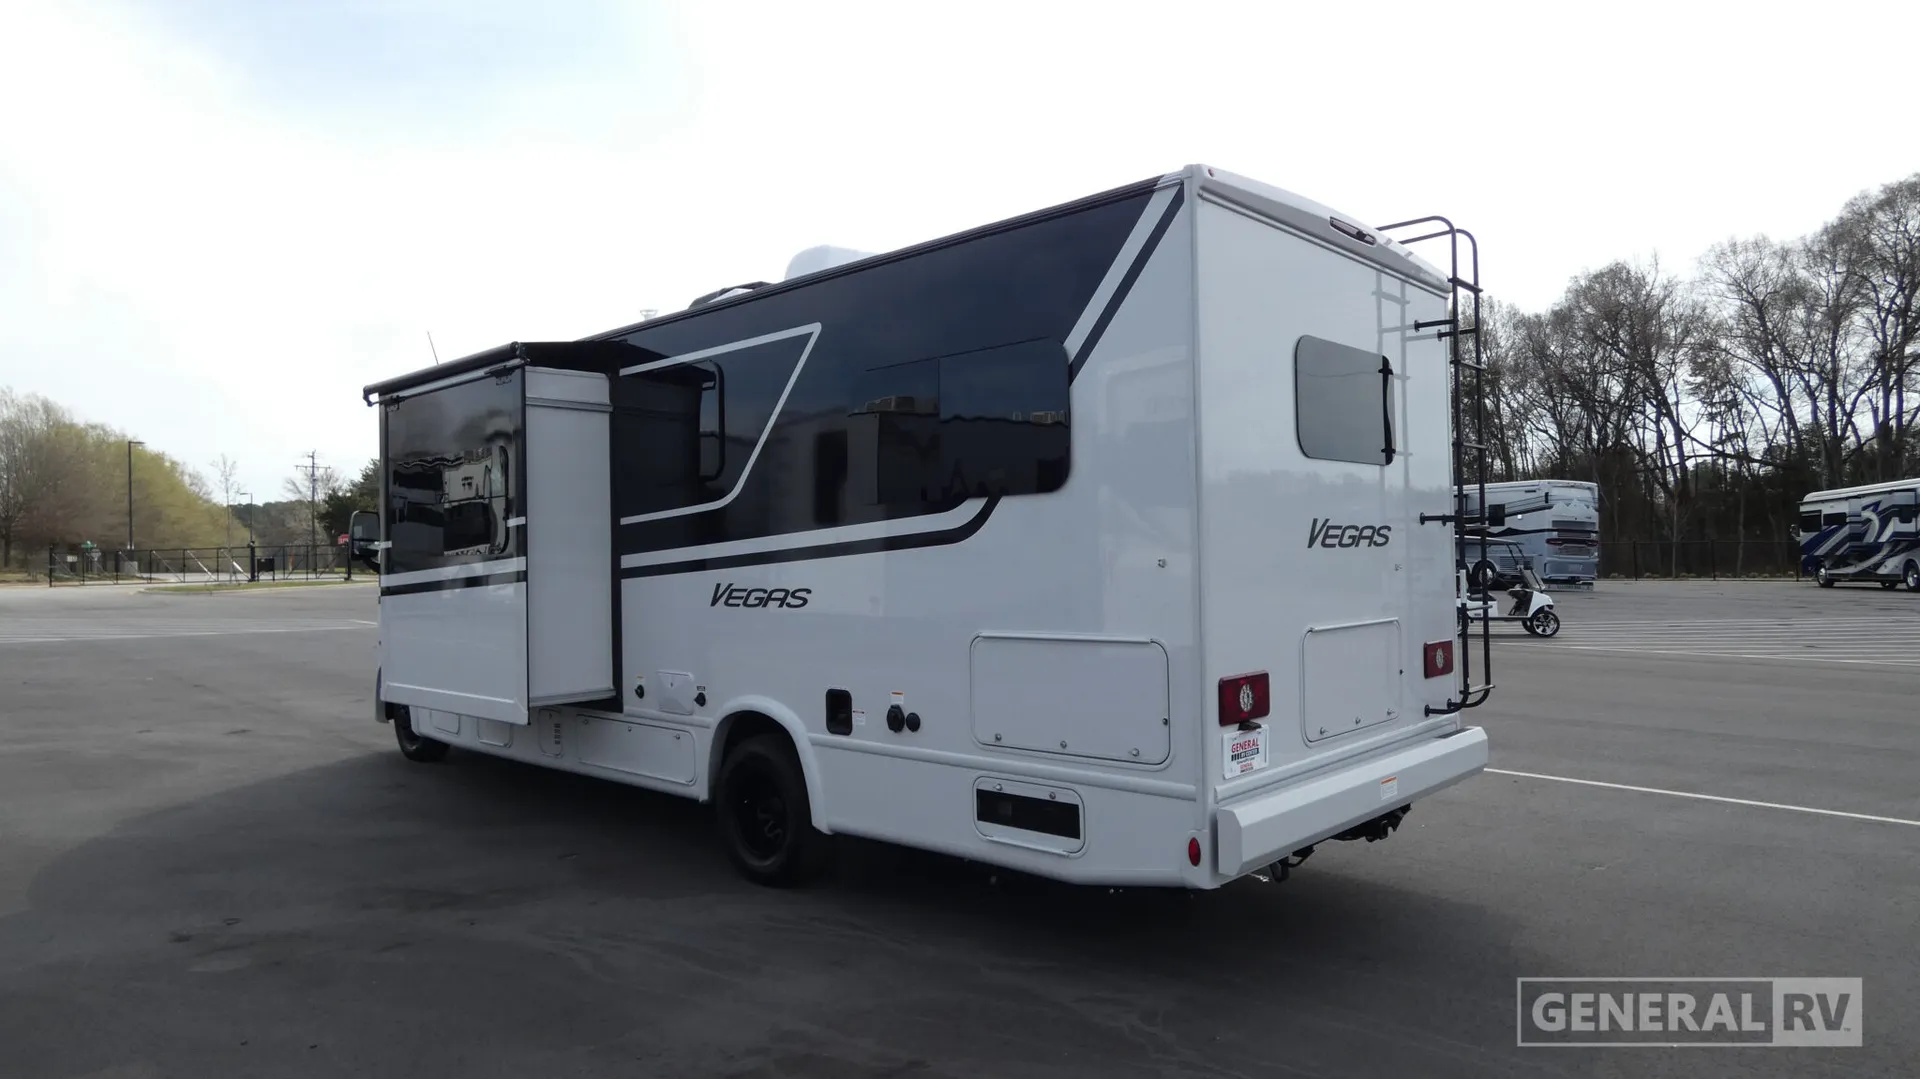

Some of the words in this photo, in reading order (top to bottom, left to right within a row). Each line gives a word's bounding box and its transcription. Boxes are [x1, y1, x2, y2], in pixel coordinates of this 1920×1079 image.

[1307, 518, 1392, 549] VEGAS
[710, 583, 812, 608] VEGAS
[1231, 738, 1259, 753] GENERAL
